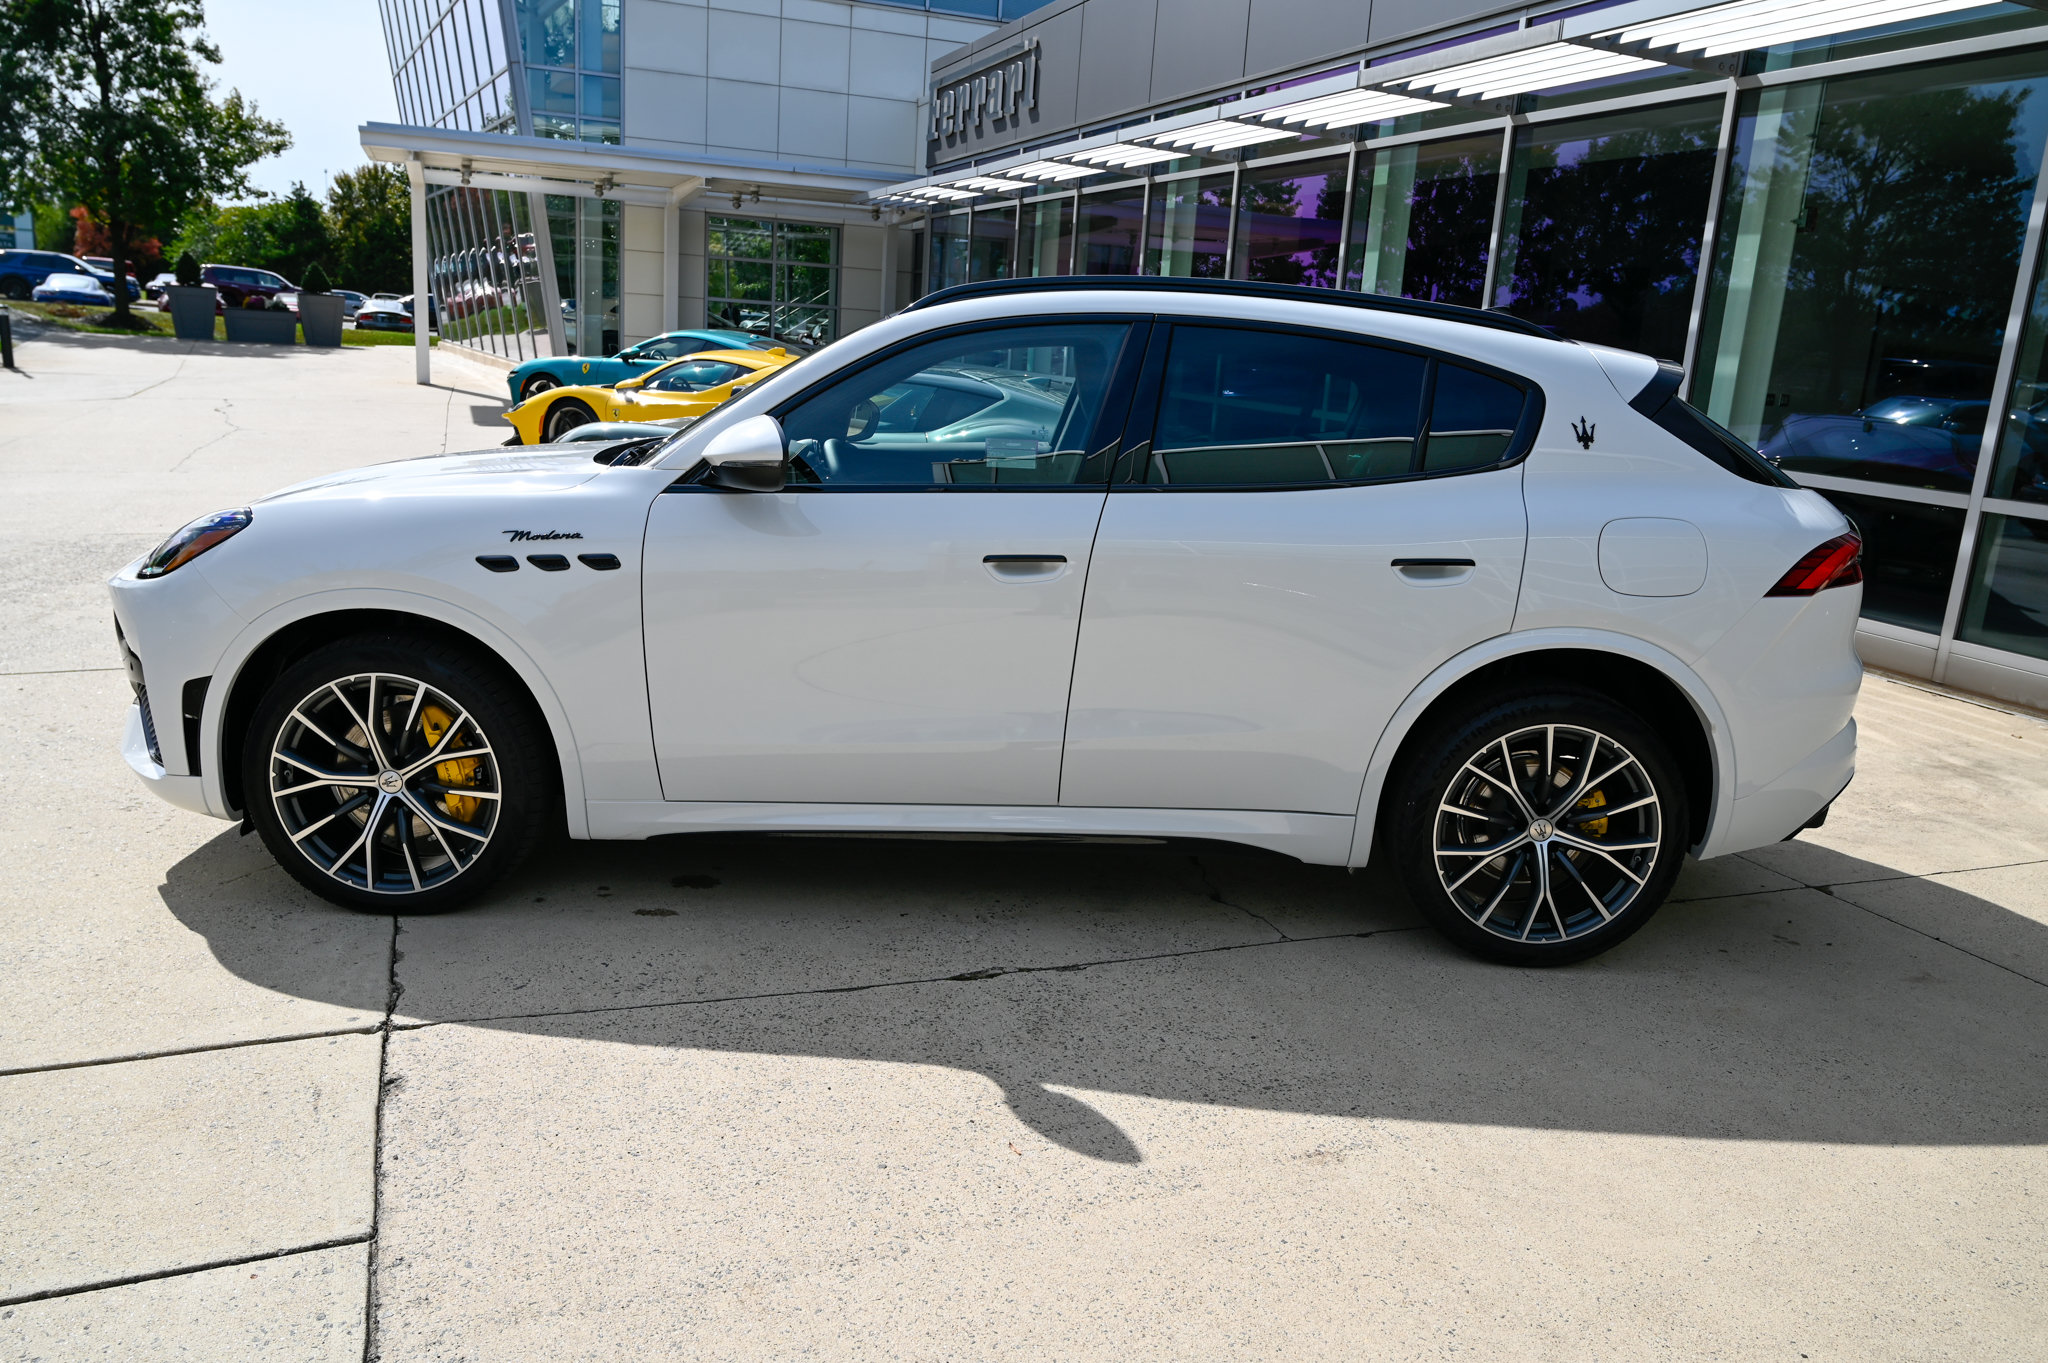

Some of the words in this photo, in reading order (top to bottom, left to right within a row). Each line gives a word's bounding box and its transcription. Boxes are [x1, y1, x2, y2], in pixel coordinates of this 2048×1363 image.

[927, 36, 1038, 141] Ferrari
[502, 529, 584, 542] Modena
[1432, 702, 1546, 780] CONTINENTAL
